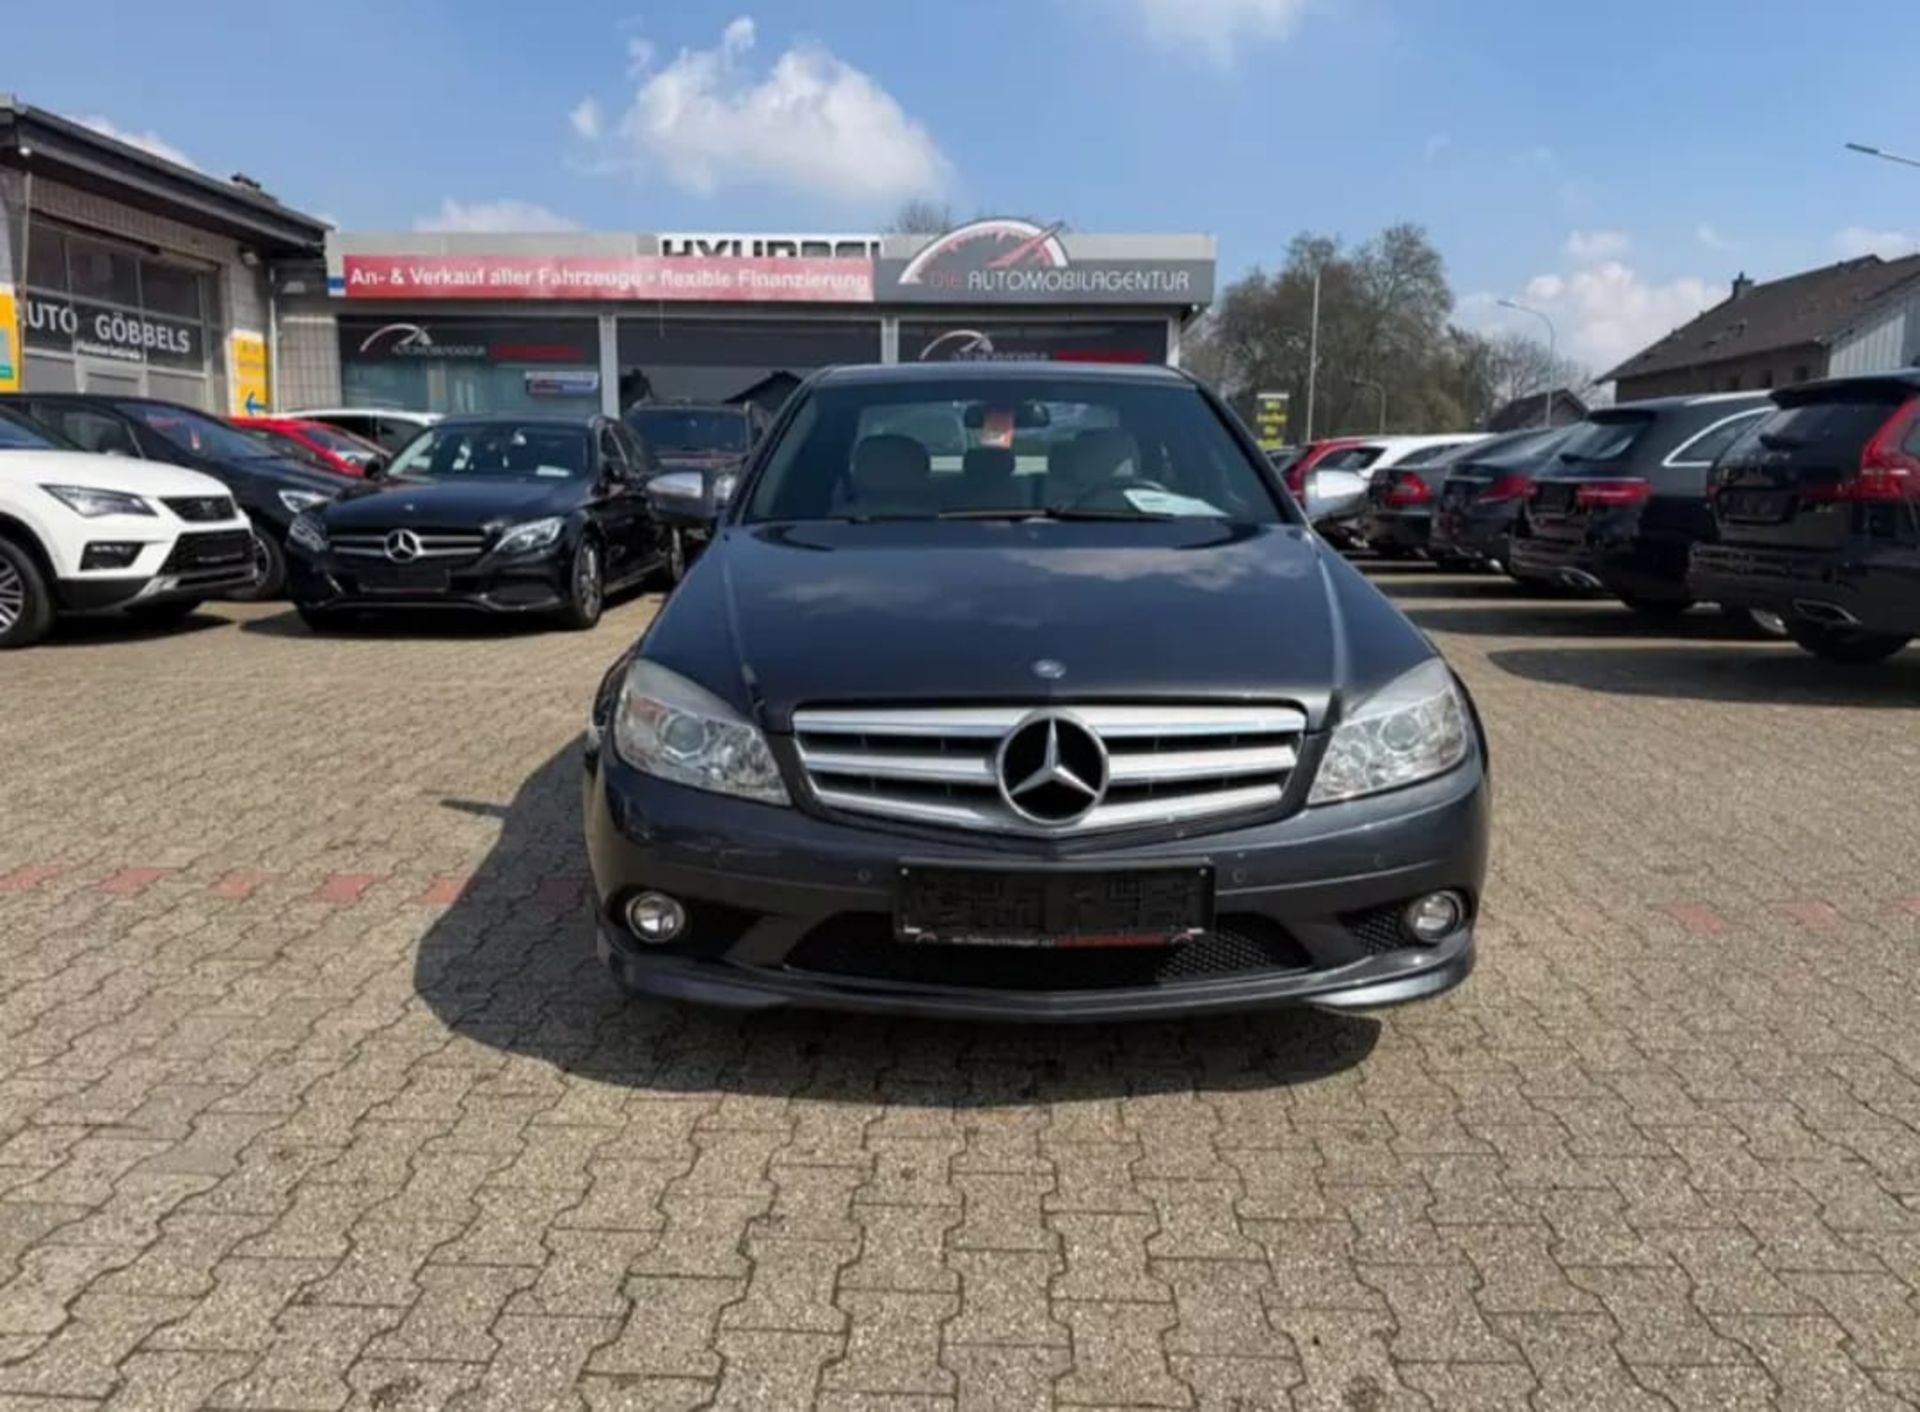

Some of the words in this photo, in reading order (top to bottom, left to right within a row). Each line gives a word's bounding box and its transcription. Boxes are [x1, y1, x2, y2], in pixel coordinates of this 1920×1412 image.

[350, 266, 386, 285] An-
[389, 266, 405, 285] &
[409, 266, 485, 285] Verkauf
[489, 267, 532, 286] aller
[537, 267, 641, 291] Fahrzeuge
[660, 268, 732, 288] flexible
[737, 268, 869, 292] Finanzierung
[967, 270, 1190, 291] AUTOMOBILAGENTUR
[22, 300, 78, 335] UTO
[94, 311, 191, 354] GÖBBELS
